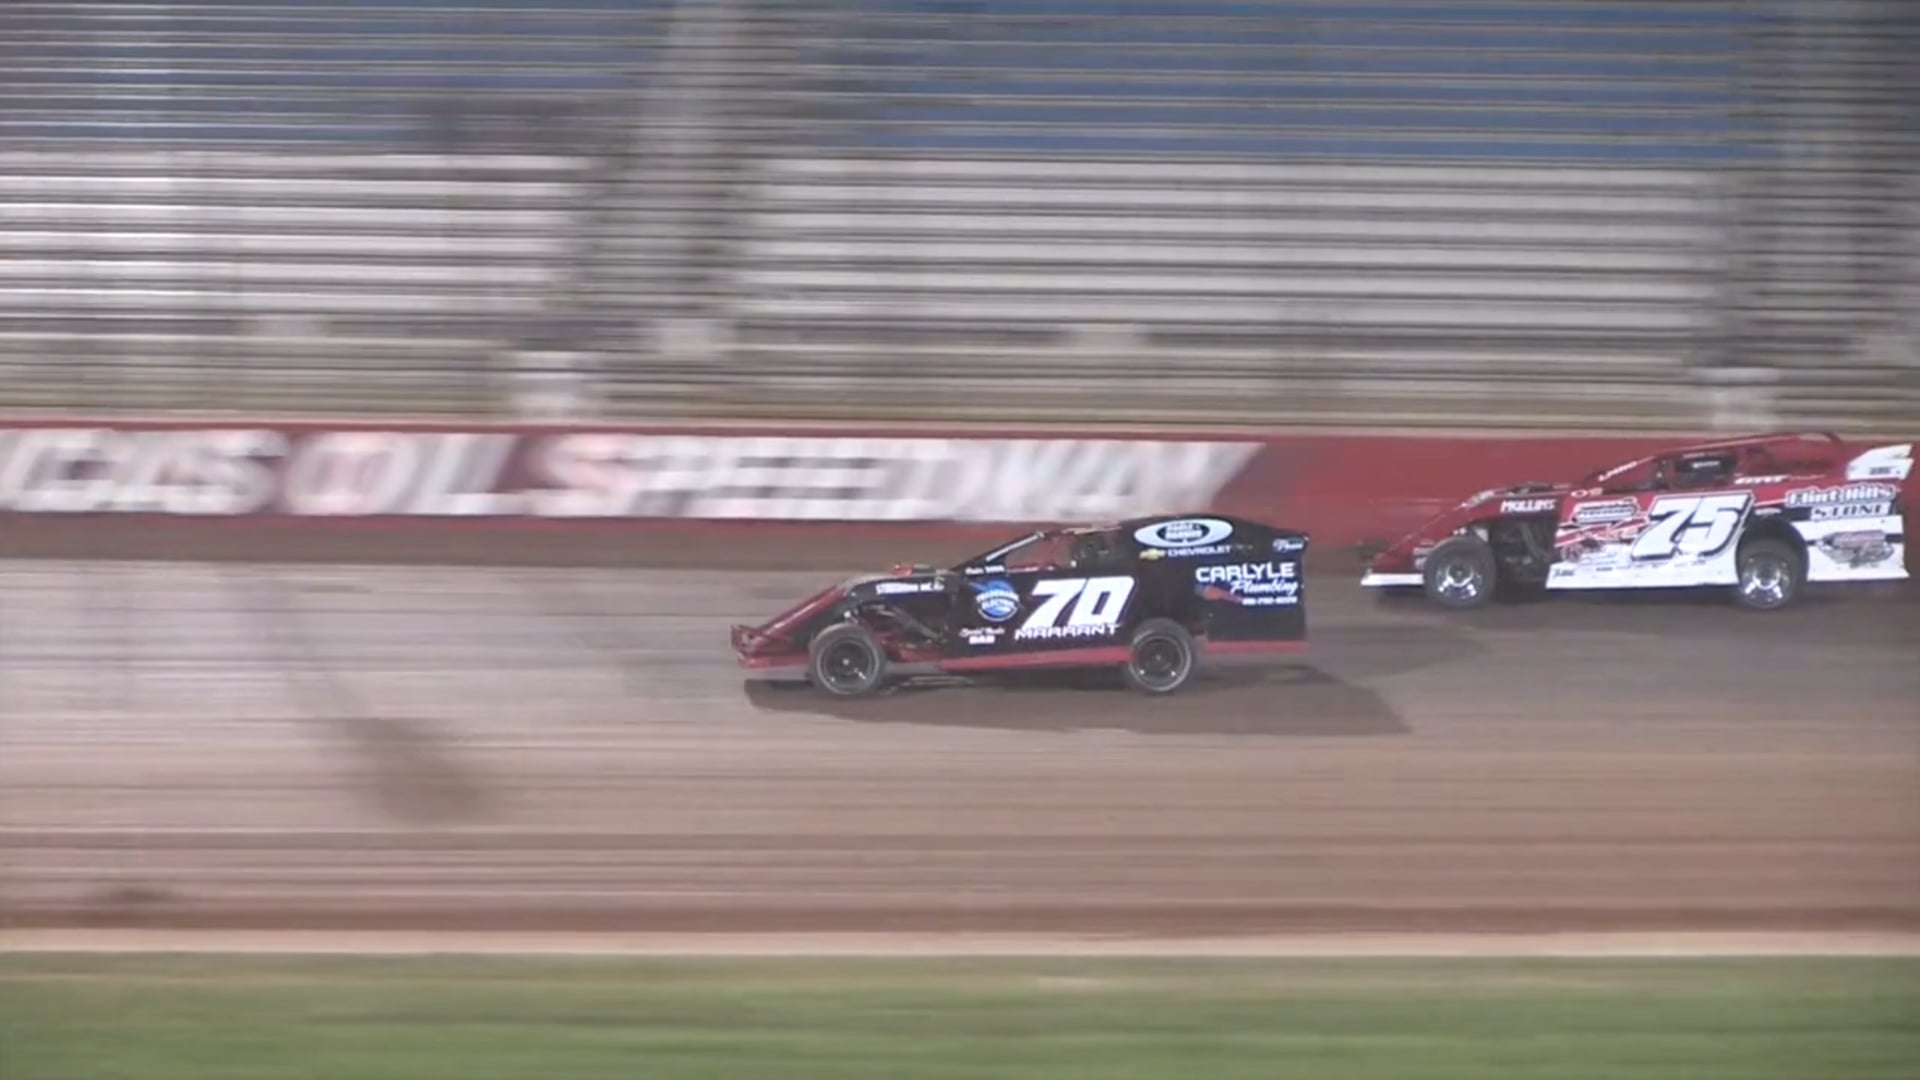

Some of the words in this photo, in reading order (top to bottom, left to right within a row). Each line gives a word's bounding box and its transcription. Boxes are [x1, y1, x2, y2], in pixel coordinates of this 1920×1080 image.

[526, 435, 1267, 523] SPEEDWAY
[1632, 491, 1754, 560] 75
[1167, 545, 1232, 557] CHEVROLET
[1195, 562, 1296, 583] CARLYLE
[1230, 578, 1298, 596] Plumbing
[1021, 576, 1135, 629] 70
